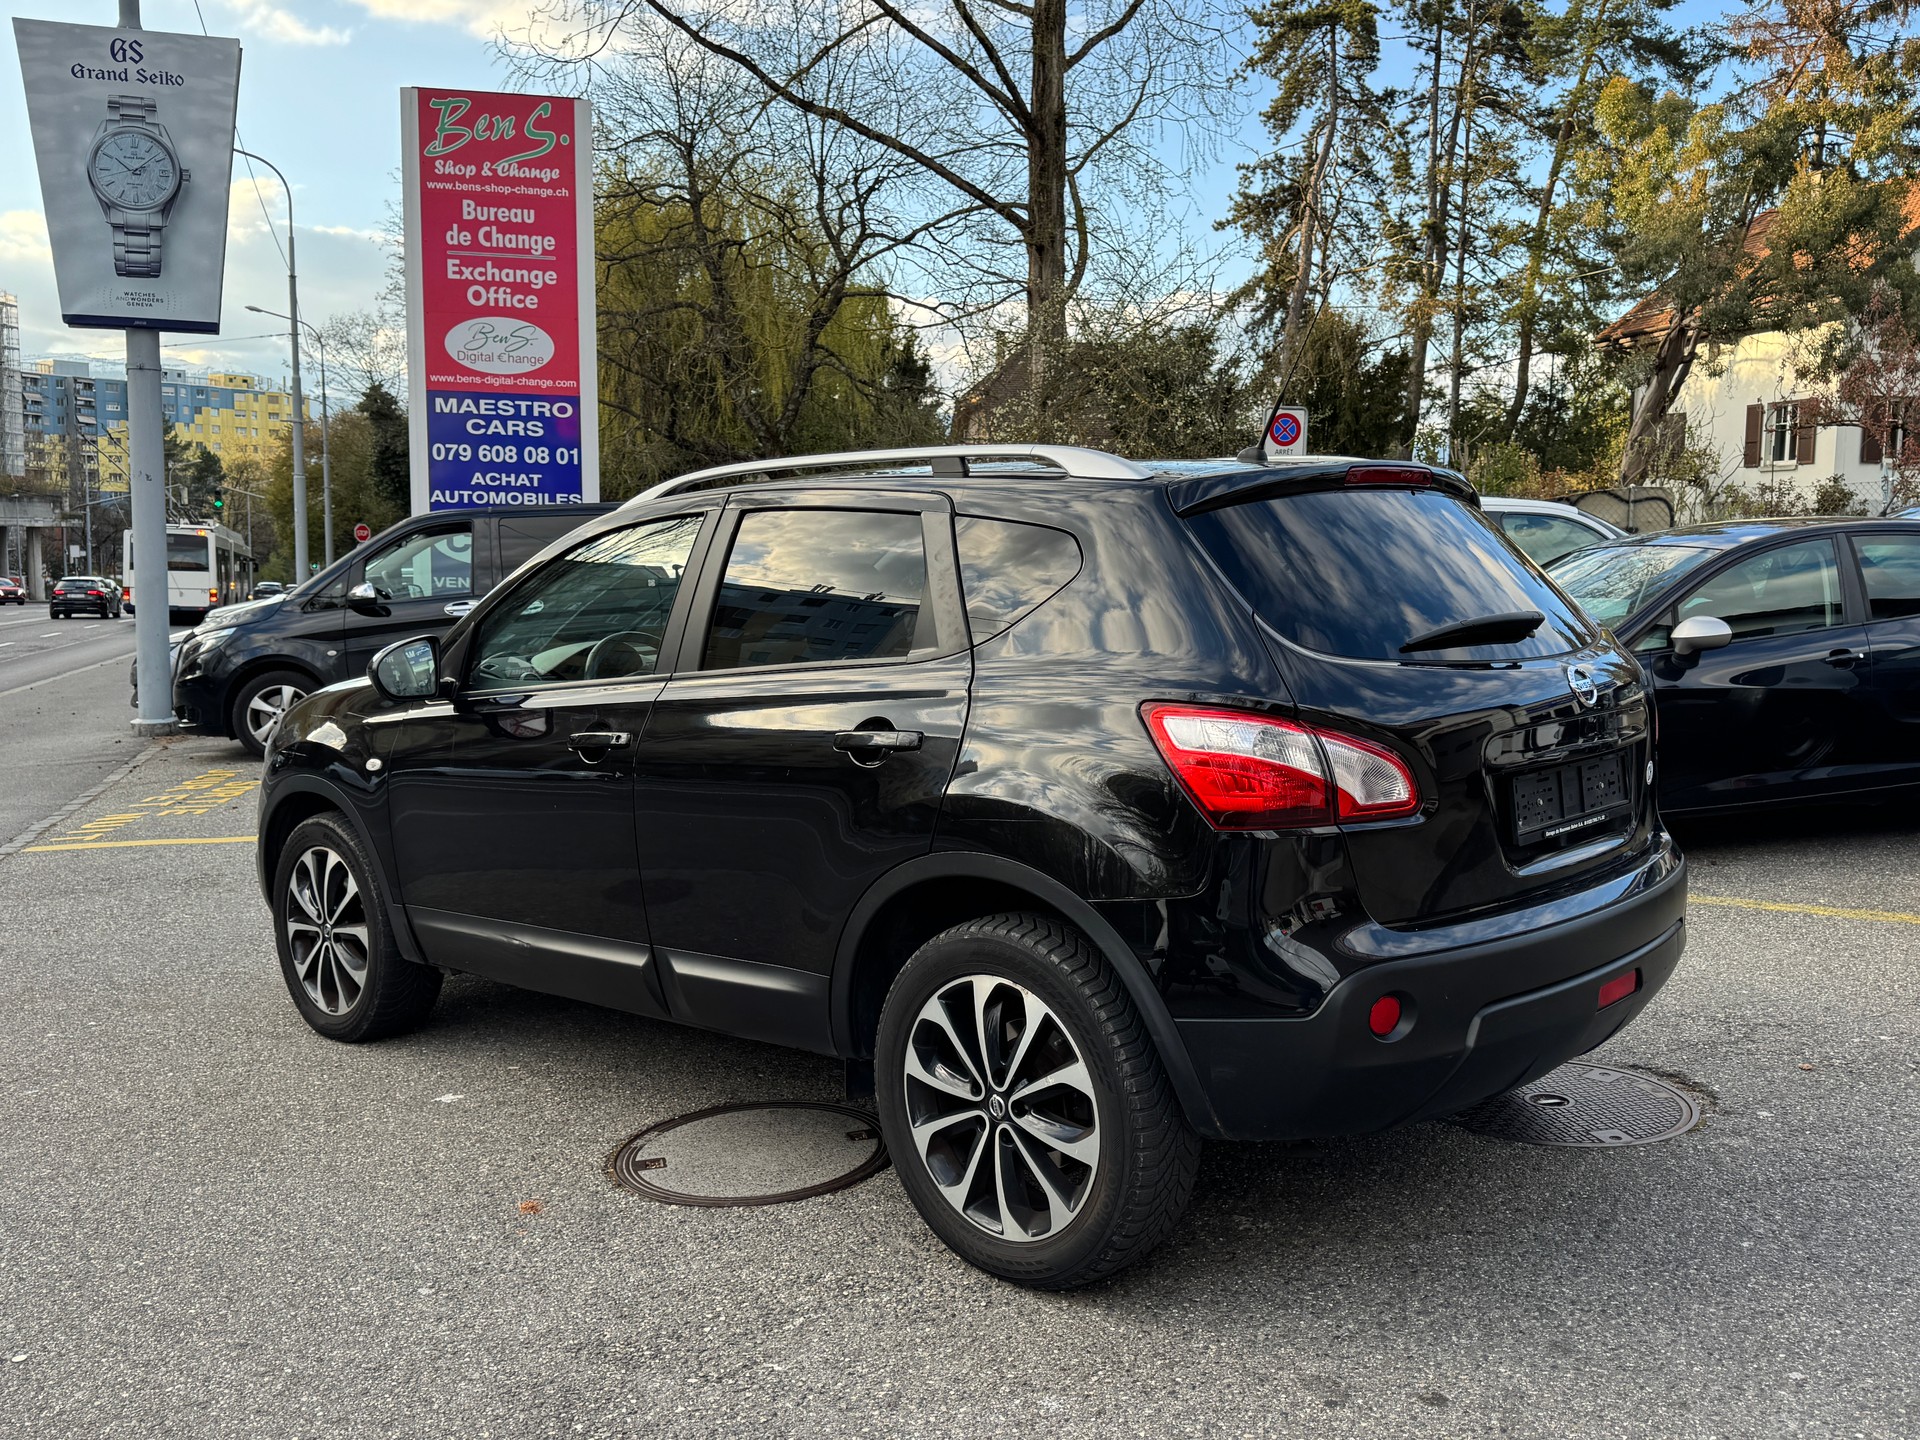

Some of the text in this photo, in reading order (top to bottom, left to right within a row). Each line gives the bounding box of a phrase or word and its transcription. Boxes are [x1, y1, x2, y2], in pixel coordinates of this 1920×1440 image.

[110, 37, 144, 65] GS
[70, 63, 185, 87] Grand Seiko
[424, 97, 570, 169] Ben S.
[434, 159, 560, 182] Shop & Change
[426, 180, 569, 198] www.bens-shop-change.ch
[462, 199, 535, 224] Bureau
[446, 223, 556, 255] de Change
[447, 258, 558, 289] Exchange
[466, 285, 539, 309] Office
[457, 350, 495, 364] Digital
[429, 374, 577, 388] www.bens-digital-change.com
[434, 397, 574, 418] MAESTRO
[465, 418, 545, 437] CARS
[431, 443, 579, 466] 079 608 08 01
[470, 472, 543, 487] ACHAT
[430, 490, 582, 506] AUTOMOBILES
[356, 529, 368, 537] STOP
